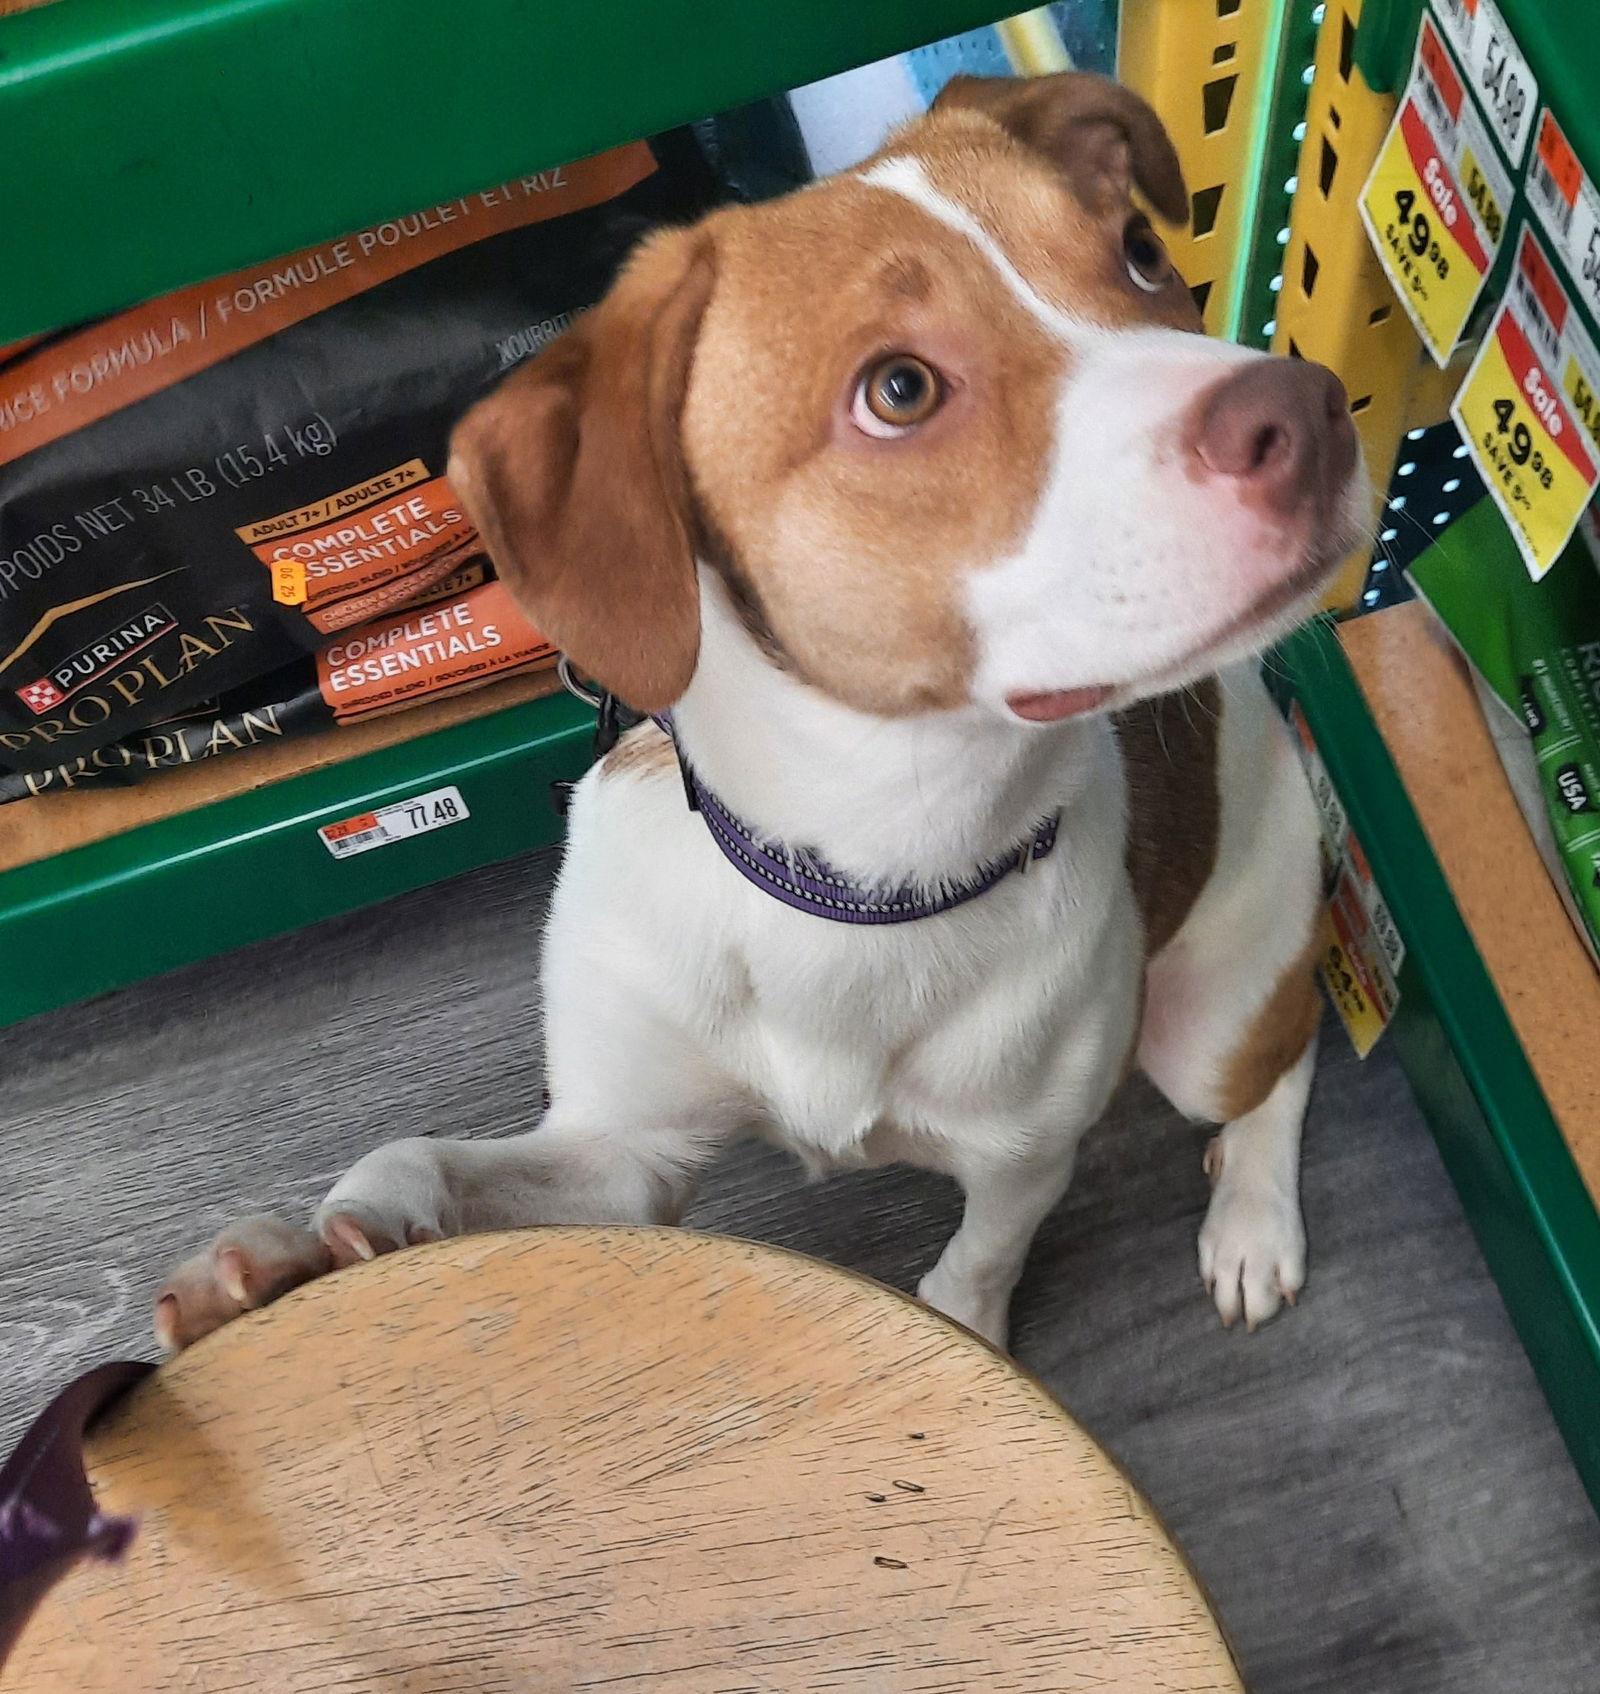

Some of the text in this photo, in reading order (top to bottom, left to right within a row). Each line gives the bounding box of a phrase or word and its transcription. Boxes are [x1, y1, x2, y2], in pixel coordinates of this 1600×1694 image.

[1423, 157, 1458, 228] Sale
[0, 383, 50, 432] ICE
[51, 316, 191, 402] FORMULA
[215, 241, 356, 324] FORMULE
[520, 166, 570, 197] RIZ
[1523, 367, 1563, 437] Sale
[74, 497, 136, 540] NET
[132, 484, 176, 514] 34
[171, 467, 217, 503] LB
[215, 432, 289, 489] (15.4
[283, 411, 338, 457] kg)
[252, 516, 298, 538] ADULT
[299, 509, 321, 527] 7+
[335, 477, 395, 511] ADULTE
[395, 469, 416, 487] 7+
[272, 496, 432, 562] COMPLETE
[303, 508, 463, 583] SSENTIALS
[54, 613, 166, 688] PURINA
[326, 603, 474, 667] COMPLETE
[329, 625, 502, 692] ESSENTIALS
[0, 606, 254, 751] PRO PLAN
[23, 704, 283, 796] PRO PLAN
[404, 797, 459, 830] 77.48
[1557, 771, 1587, 811] USA
